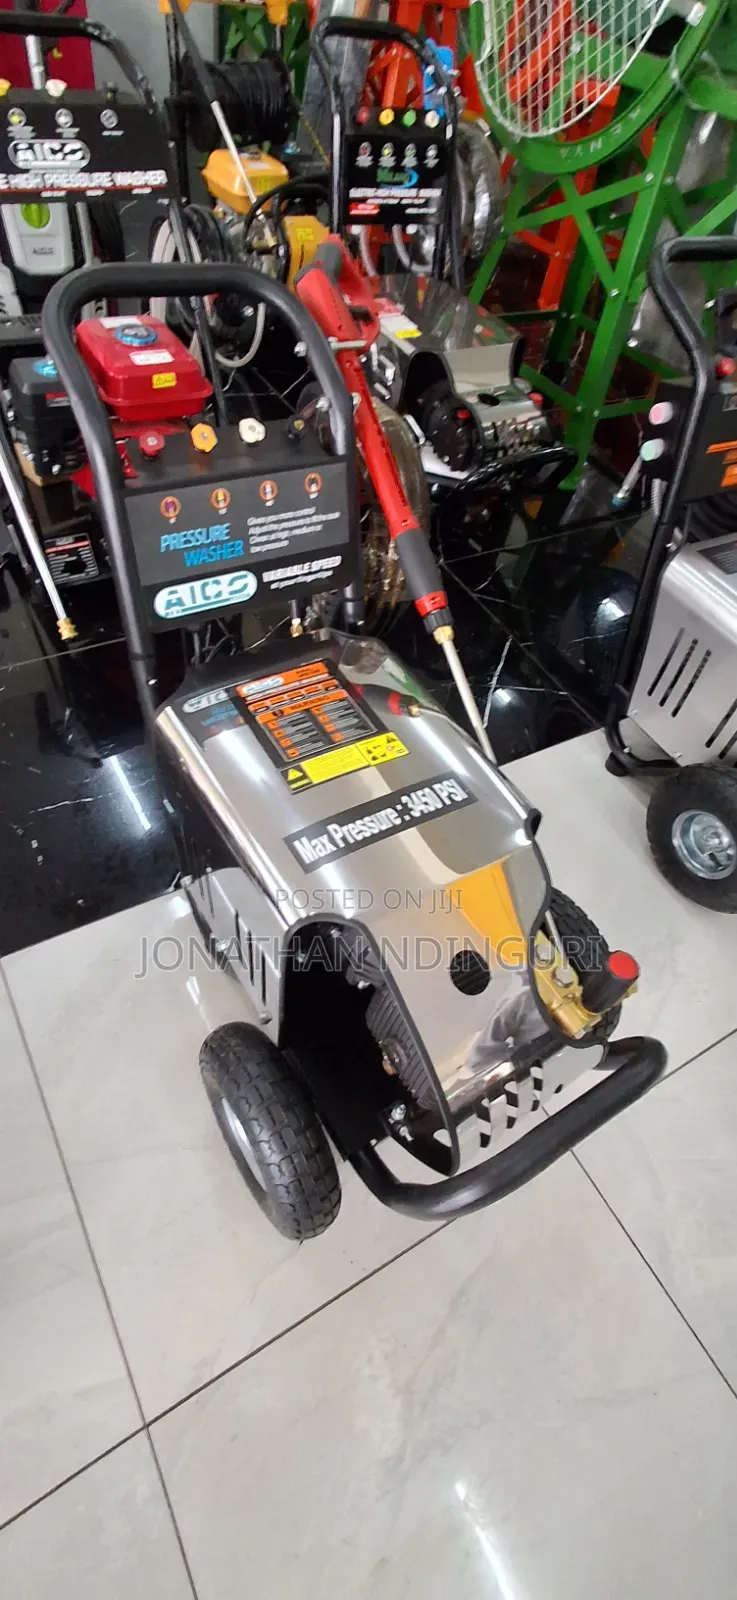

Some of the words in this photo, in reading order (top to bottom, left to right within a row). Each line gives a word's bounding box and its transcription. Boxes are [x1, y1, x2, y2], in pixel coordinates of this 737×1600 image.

[16, 142, 85, 162] AICS
[8, 173, 44, 189] HIGH
[44, 171, 115, 189] PRESSURE
[112, 170, 168, 187] WASHER
[160, 522, 231, 552] PRESSURE
[184, 540, 244, 568] WASHER
[262, 562, 311, 583] VARIABLE
[311, 555, 342, 572] SPEED
[164, 574, 248, 611] AICS
[293, 832, 337, 865] Max
[326, 806, 402, 848] Pressure
[401, 787, 444, 818] 3450
[434, 778, 468, 805] PSI
